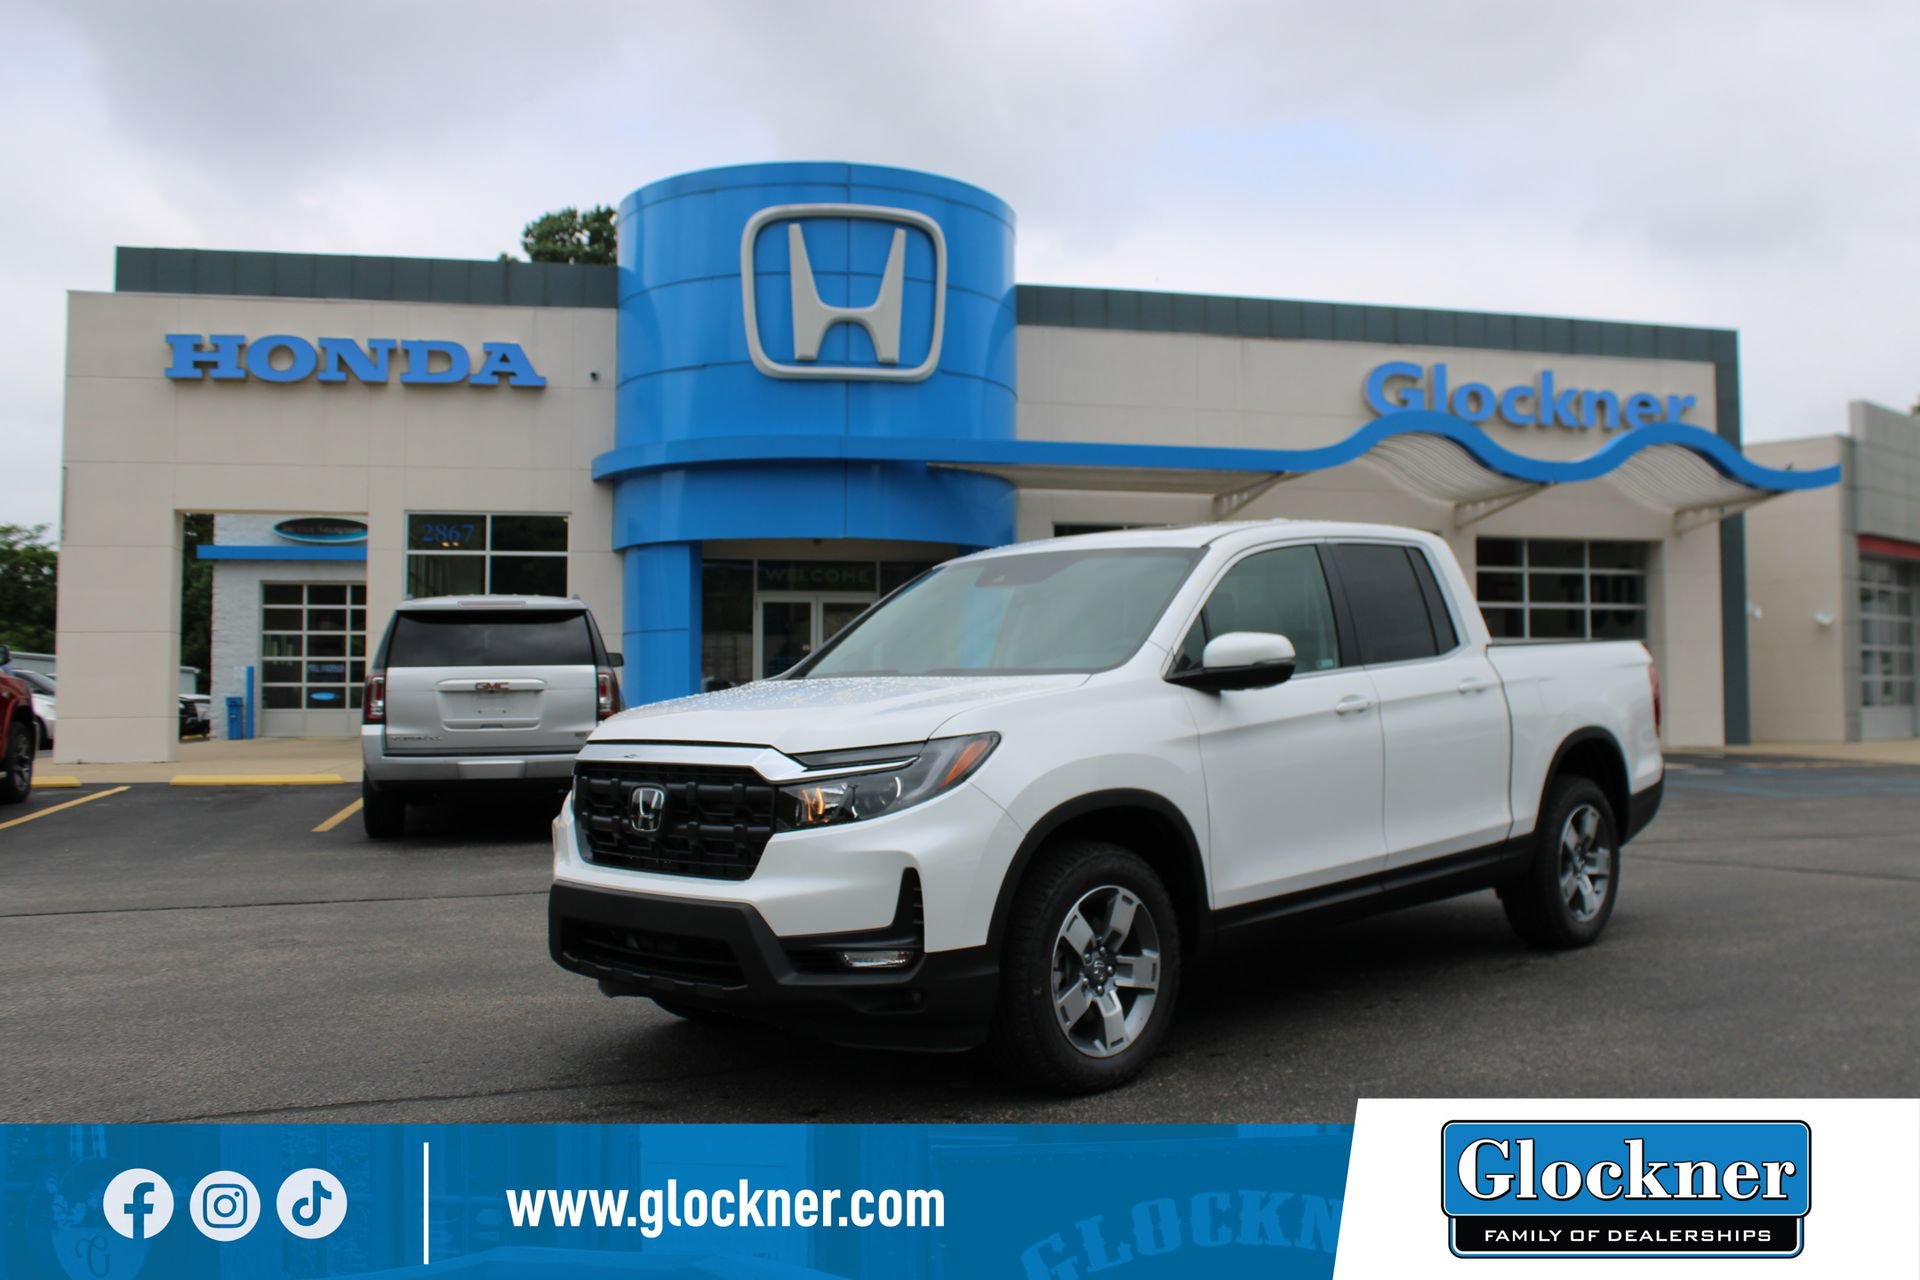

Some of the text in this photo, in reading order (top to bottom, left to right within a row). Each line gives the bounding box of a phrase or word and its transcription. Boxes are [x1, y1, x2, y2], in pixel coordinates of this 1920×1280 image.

[164, 333, 547, 388] HONDA
[1365, 360, 1697, 429] Glockner
[420, 523, 475, 543] 2867
[765, 567, 870, 583] WELCOME
[475, 682, 509, 690] GMC
